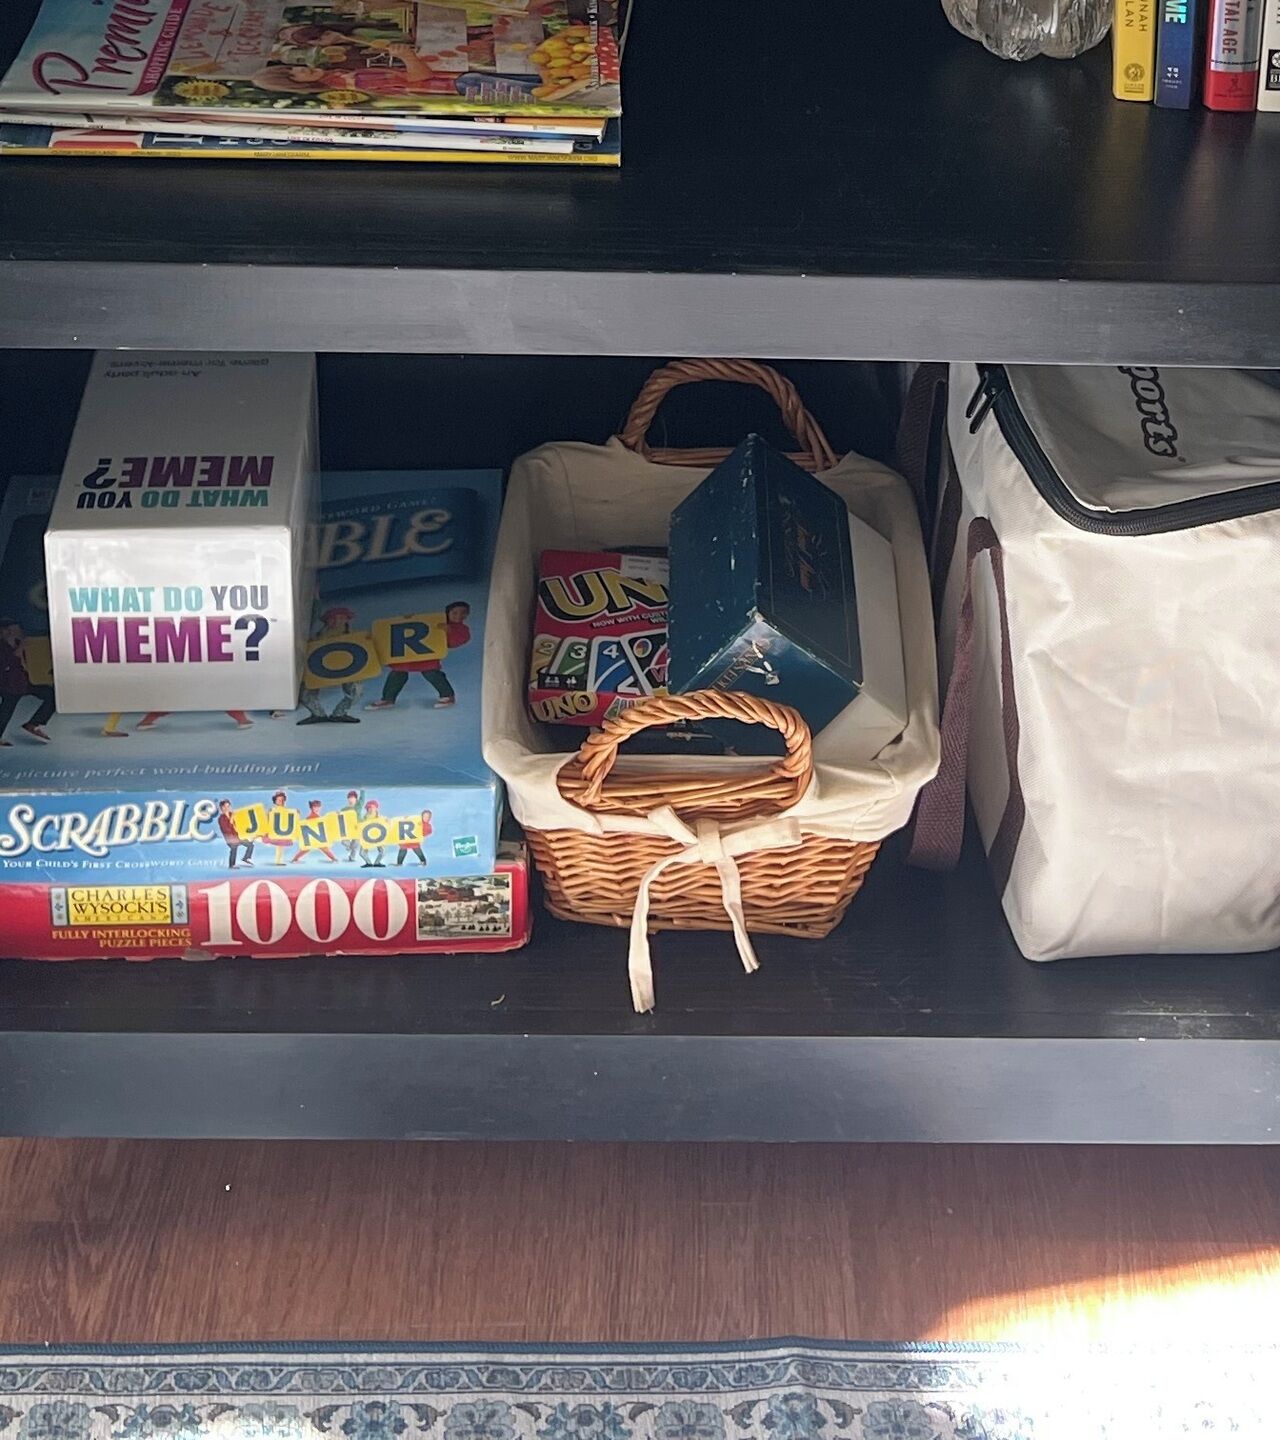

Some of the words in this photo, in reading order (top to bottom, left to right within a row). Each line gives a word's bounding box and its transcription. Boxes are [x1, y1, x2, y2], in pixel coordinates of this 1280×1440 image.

[143, 37, 173, 86] SHOPPING
[162, 7, 183, 39] GUIDE
[1222, 28, 1239, 55] AGE
[1117, 365, 1179, 458] ports
[82, 455, 275, 490] MEME?
[76, 490, 133, 509] YOU
[141, 489, 181, 509] DO
[185, 489, 269, 508] WHAT
[318, 508, 454, 569] BLE
[69, 587, 155, 613] WHAT
[163, 586, 204, 612] DO
[211, 585, 270, 612] YOU
[539, 568, 668, 621] UN
[591, 619, 615, 628] NOW
[616, 614, 640, 623] WITH
[70, 615, 272, 665] MEME?
[570, 644, 588, 659] 3
[602, 644, 620, 659] 4
[530, 691, 598, 723] UNO
[15, 767, 78, 780] picture
[84, 766, 146, 779] perfect
[153, 763, 277, 776] word-building
[280, 761, 321, 774] fun!
[246, 808, 417, 847] JUNIOR
[3, 859, 33, 869] YOUR
[35, 858, 79, 869] CHILD'S
[82, 859, 111, 869] FIRST
[115, 859, 185, 869] CROSSWORD
[71, 887, 167, 902] CHARLES
[73, 901, 168, 914] WYSOCKI'S
[198, 877, 409, 947] 1000
[52, 930, 89, 940] FULLY
[92, 928, 192, 939] INTERLOCKING
[99, 939, 144, 949] PUZZLE
[145, 938, 192, 948] PIECES
